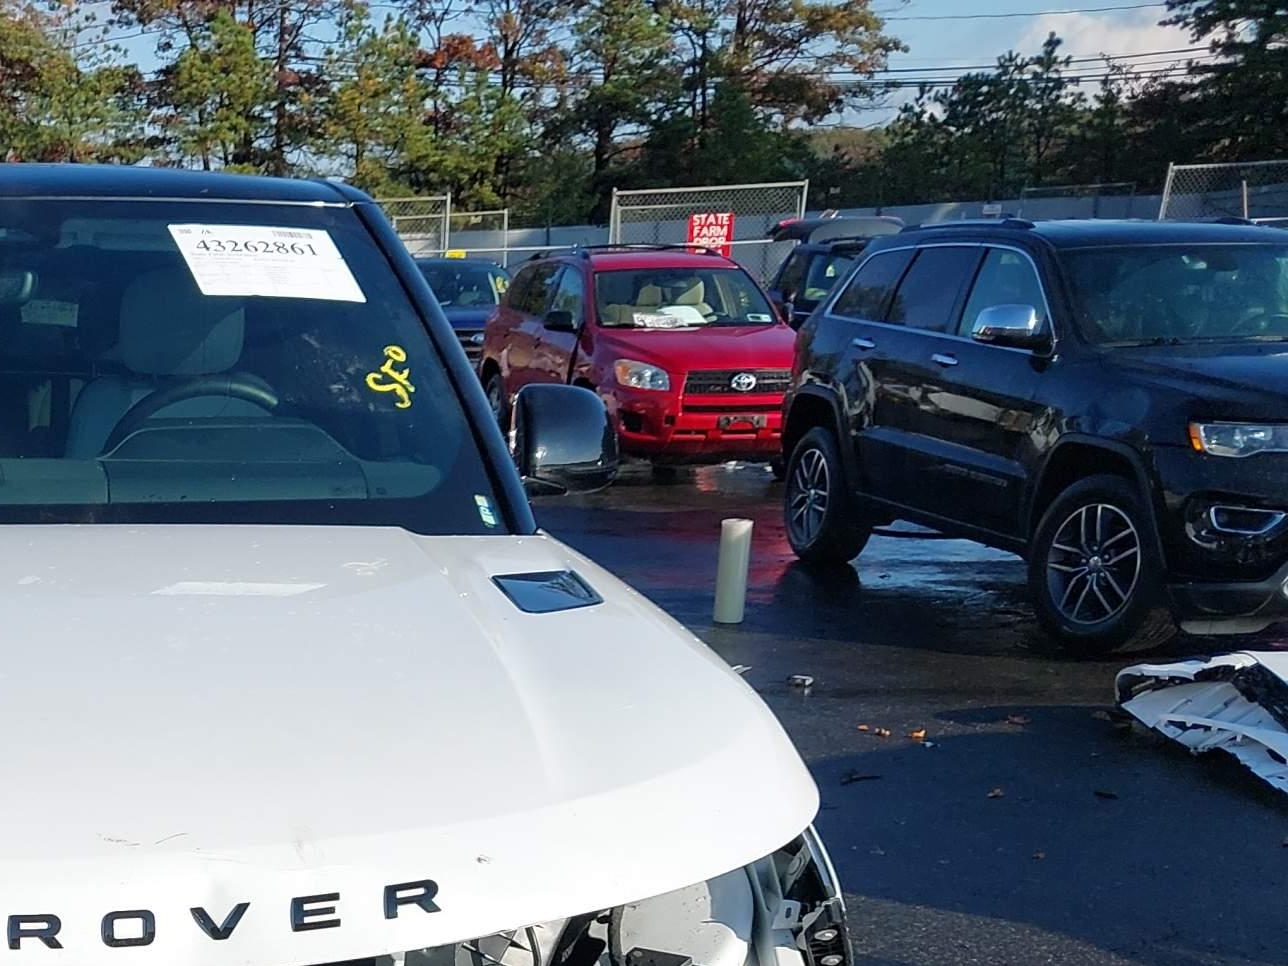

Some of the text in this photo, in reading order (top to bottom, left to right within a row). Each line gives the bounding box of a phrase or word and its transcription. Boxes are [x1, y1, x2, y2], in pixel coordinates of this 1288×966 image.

[692, 213, 730, 226] STATE
[692, 225, 728, 237] FARM
[196, 239, 318, 257] 43262861
[6, 878, 443, 950] ROVER
